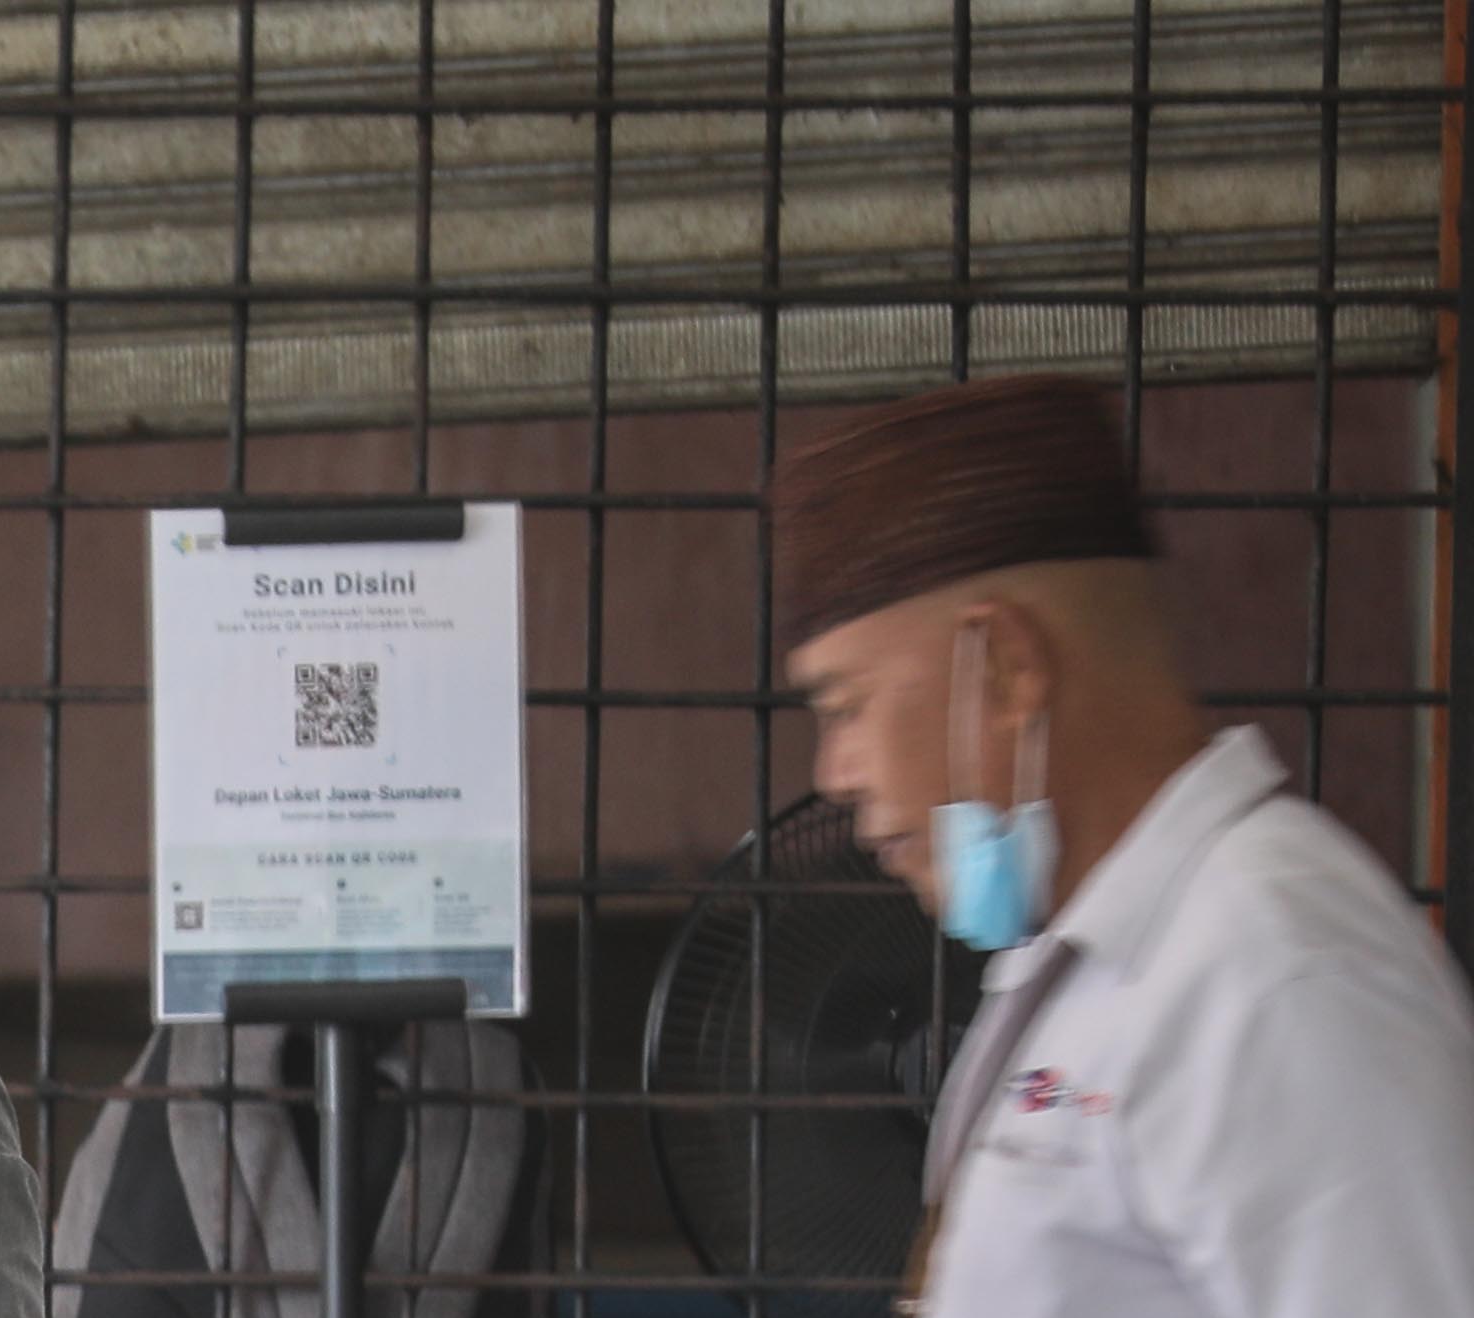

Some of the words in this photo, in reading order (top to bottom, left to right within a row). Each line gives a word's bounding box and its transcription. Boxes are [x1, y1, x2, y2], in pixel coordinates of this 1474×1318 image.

[253, 572, 324, 597] Scan
[334, 569, 416, 596] Disini
[214, 786, 268, 805] Depan
[273, 784, 321, 803] Loket
